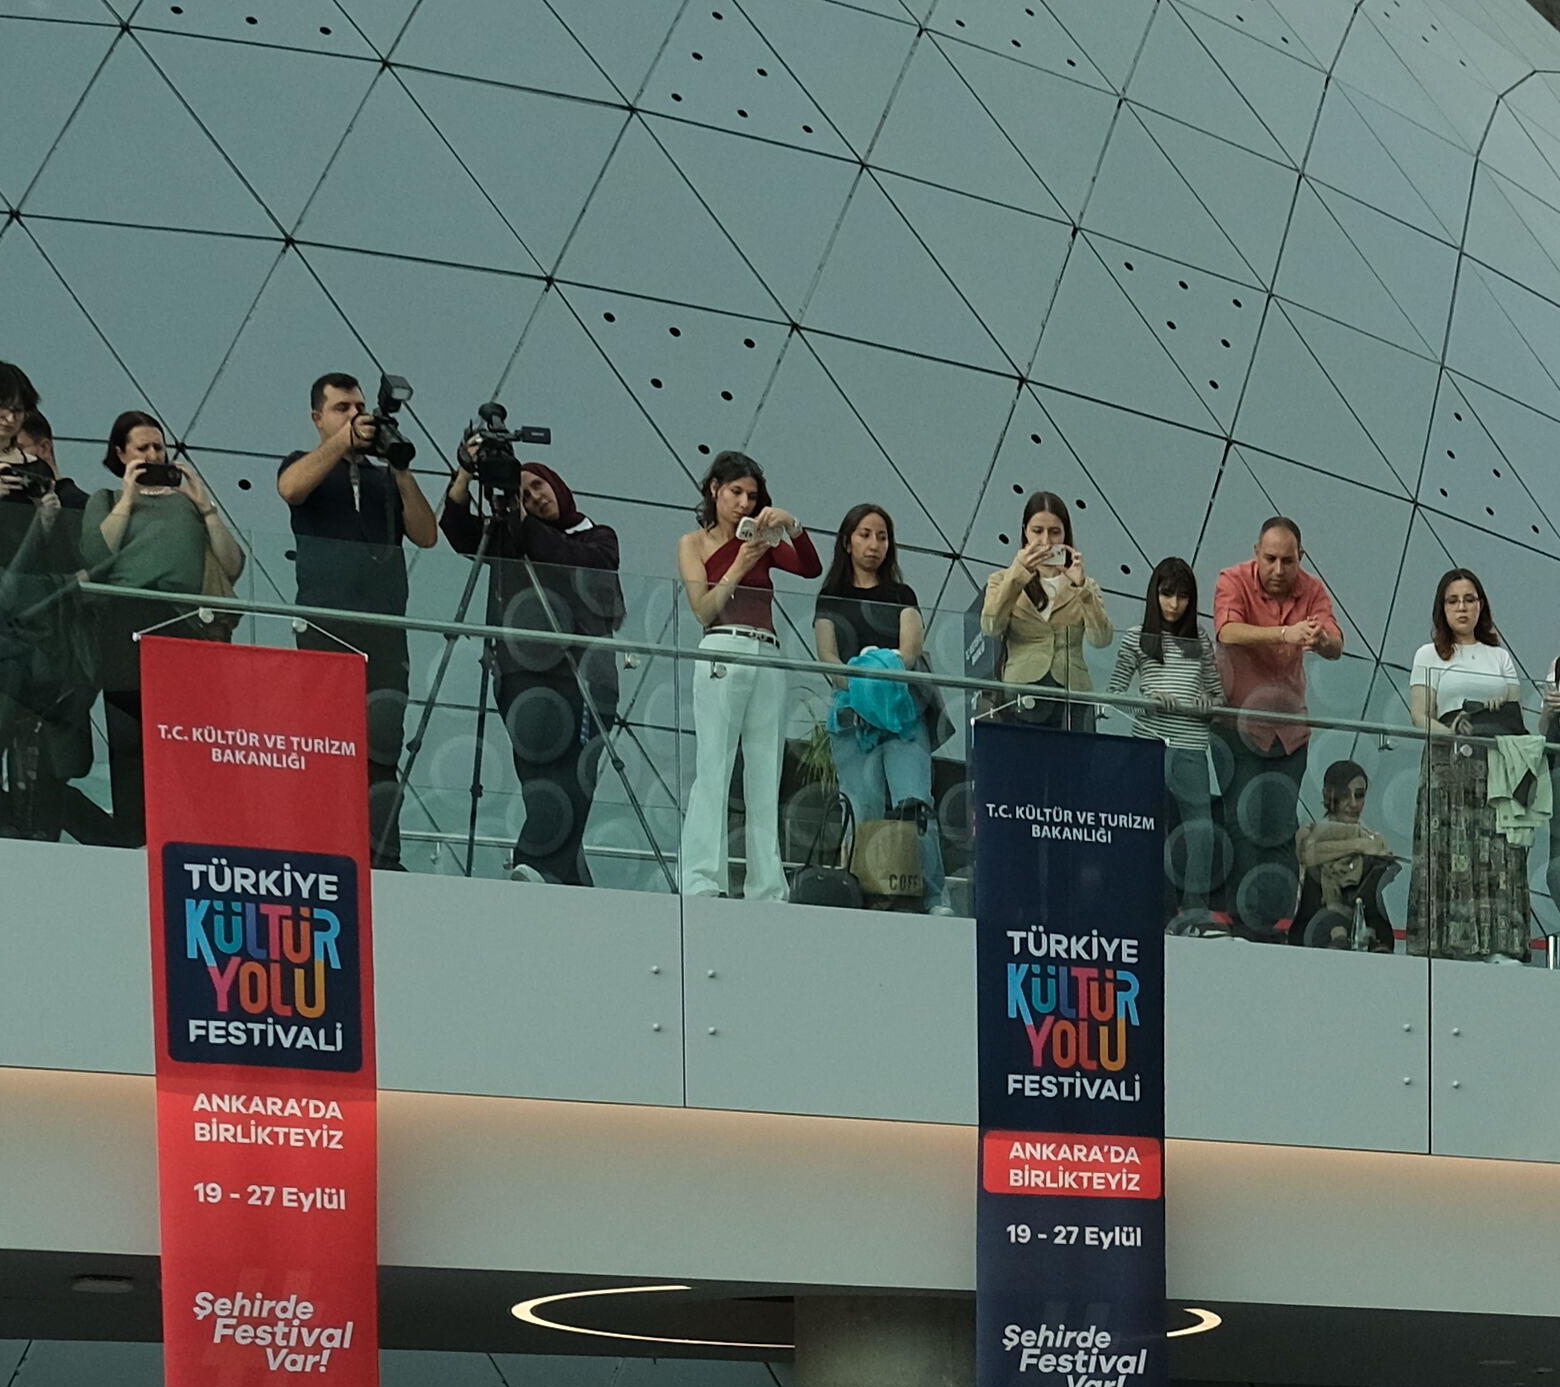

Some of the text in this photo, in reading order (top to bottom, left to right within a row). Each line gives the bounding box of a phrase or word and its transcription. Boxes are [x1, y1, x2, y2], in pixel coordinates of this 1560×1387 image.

[158, 725, 356, 756] T.C. KÜLTÜR VE TURİZM
[211, 747, 305, 770] BAKANLIĞI
[986, 804, 1154, 831] T.C. KÜLTÜR VE TURİZM
[1032, 824, 1112, 843] BAKANLIĞI
[184, 859, 338, 901] TÜRKİYE
[186, 899, 342, 969] KÜLTÜR
[1007, 926, 1138, 963] TÜRKİYE
[207, 956, 326, 1018] YOLU
[1008, 964, 1140, 1027] KÜLTÜR
[188, 1017, 344, 1052] FESTİVALİ
[1026, 1015, 1126, 1071] YOLU
[1008, 1072, 1141, 1102] FESTİVALİ
[192, 1093, 343, 1120] ANKARA'DA
[194, 1120, 344, 1149] BİRLİKTEYİZ
[1009, 1141, 1140, 1165] ANKARA'DA
[1009, 1167, 1140, 1191] BİRLİKTEYİZ
[194, 1184, 221, 1203] 19
[247, 1186, 275, 1205] 27
[283, 1188, 345, 1212] Eylül
[1006, 1225, 1141, 1250] 19 27 Eylül
[193, 1291, 314, 1320] Şehirde
[213, 1318, 352, 1348] Festival
[1002, 1325, 1111, 1351] Şehirde
[266, 1348, 329, 1373] Var!
[1019, 1347, 1147, 1374] Festival
